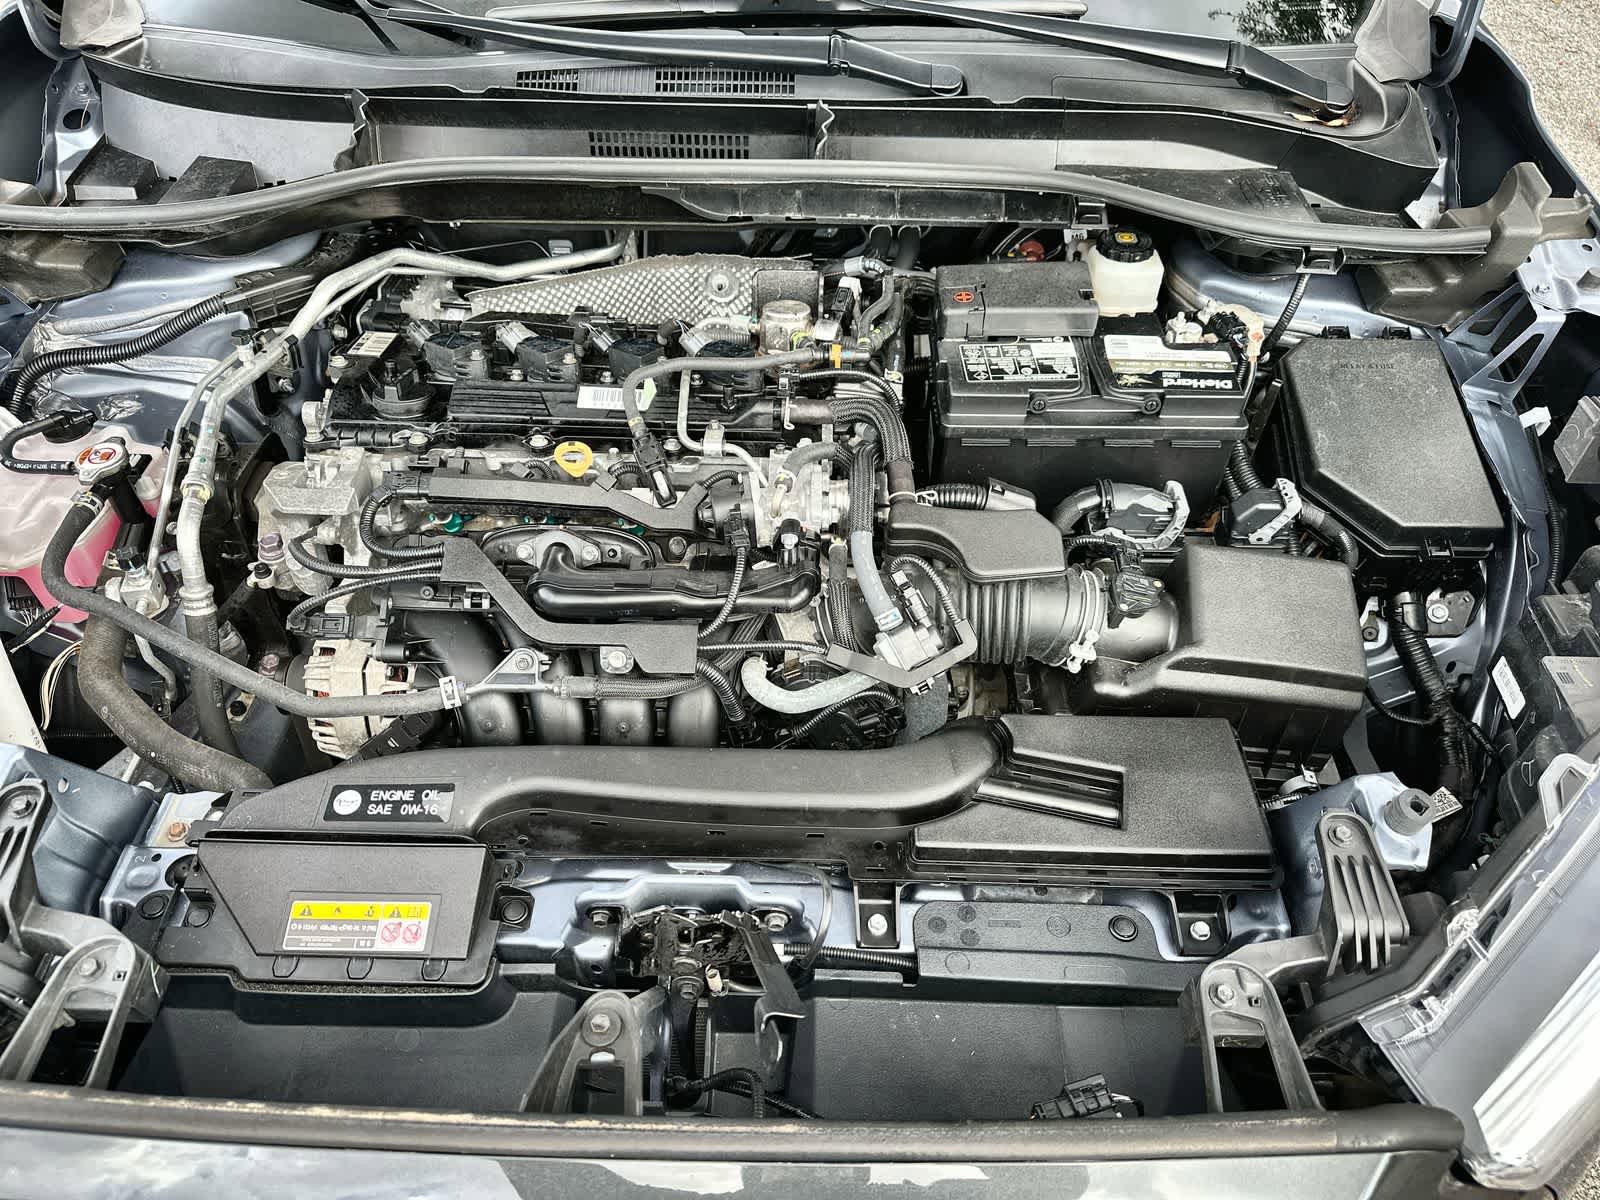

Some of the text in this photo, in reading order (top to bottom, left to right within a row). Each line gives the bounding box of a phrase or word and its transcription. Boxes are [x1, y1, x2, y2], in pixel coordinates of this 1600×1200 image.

[1162, 378, 1233, 389] DieHard
[370, 789, 415, 801] ENGINE
[421, 789, 440, 801] OIL
[367, 803, 438, 815] SAE 0W-16
